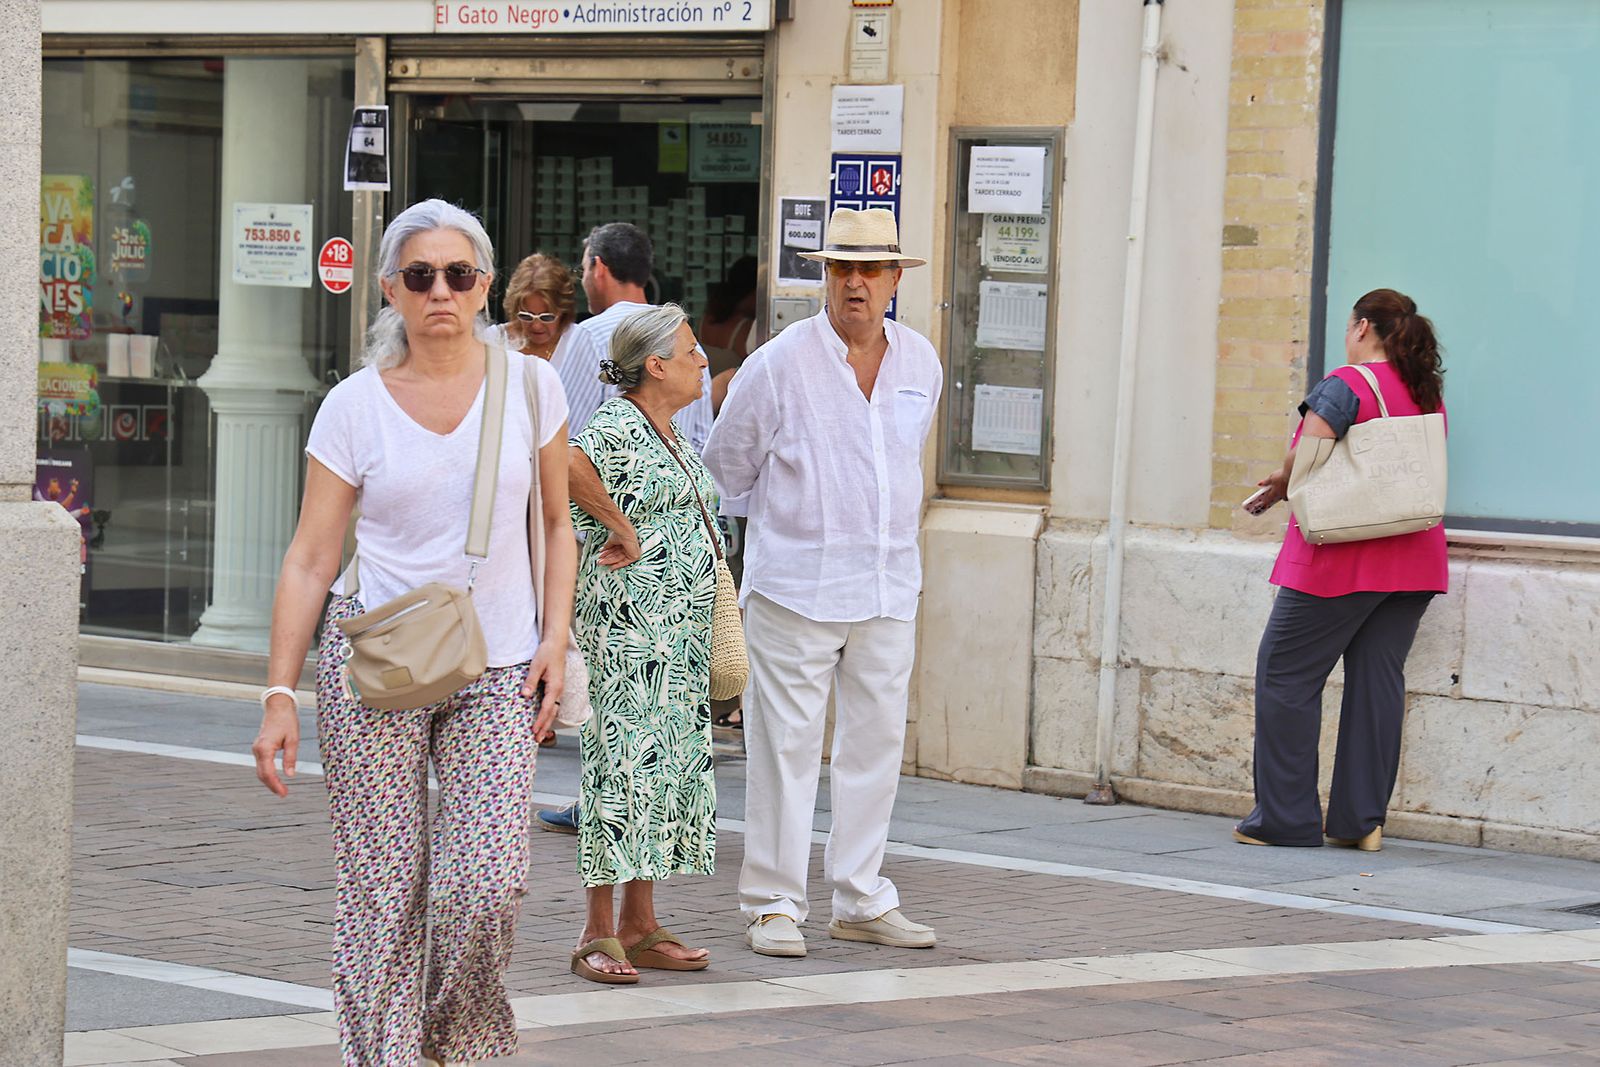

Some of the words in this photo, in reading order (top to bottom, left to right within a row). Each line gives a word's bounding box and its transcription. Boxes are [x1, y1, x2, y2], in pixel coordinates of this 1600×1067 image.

[436, 5, 449, 24] El
[458, 5, 498, 24] Gato
[507, 5, 559, 29] Negro
[573, 2, 703, 23] Administración
[742, 1, 752, 21] 2
[996, 189, 1022, 197] CERRADO
[44, 192, 74, 225] VA
[794, 203, 812, 216] BOTE
[993, 215, 1015, 223] GRAN
[1017, 215, 1046, 225] PREMIO
[43, 224, 76, 252] CA
[121, 229, 129, 243] 5
[244, 228, 290, 242] 753.850
[294, 230, 301, 242] €
[788, 231, 816, 239] 600.000
[998, 226, 1034, 238] 44.199
[112, 240, 145, 260] JULIO
[327, 243, 348, 262] +18
[992, 255, 1022, 263] VENDIDO
[40, 253, 82, 283] CIO
